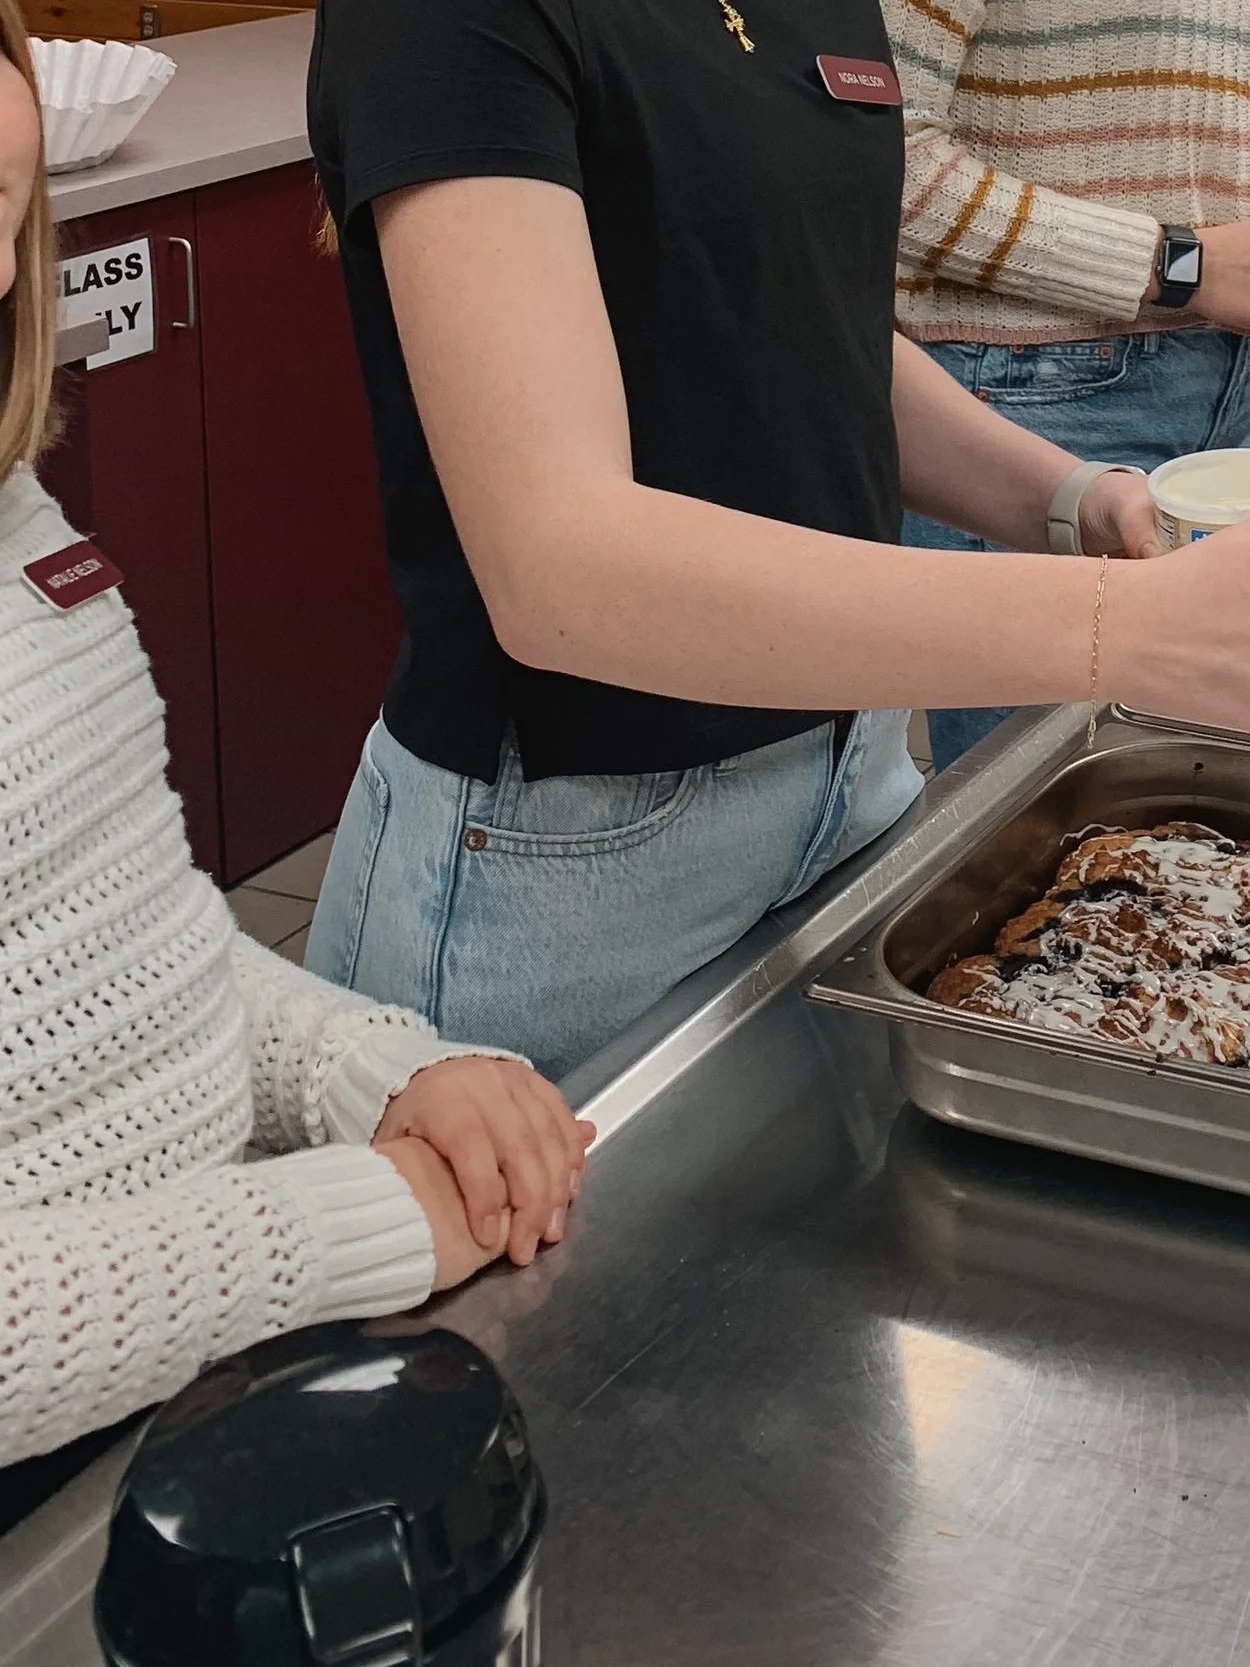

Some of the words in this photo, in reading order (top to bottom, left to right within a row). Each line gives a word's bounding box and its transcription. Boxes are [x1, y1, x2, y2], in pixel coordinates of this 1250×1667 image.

[838, 72, 860, 85] NORA
[858, 74, 886, 88] NELSON
[57, 252, 143, 297] LASS
[95, 301, 142, 335] LY
